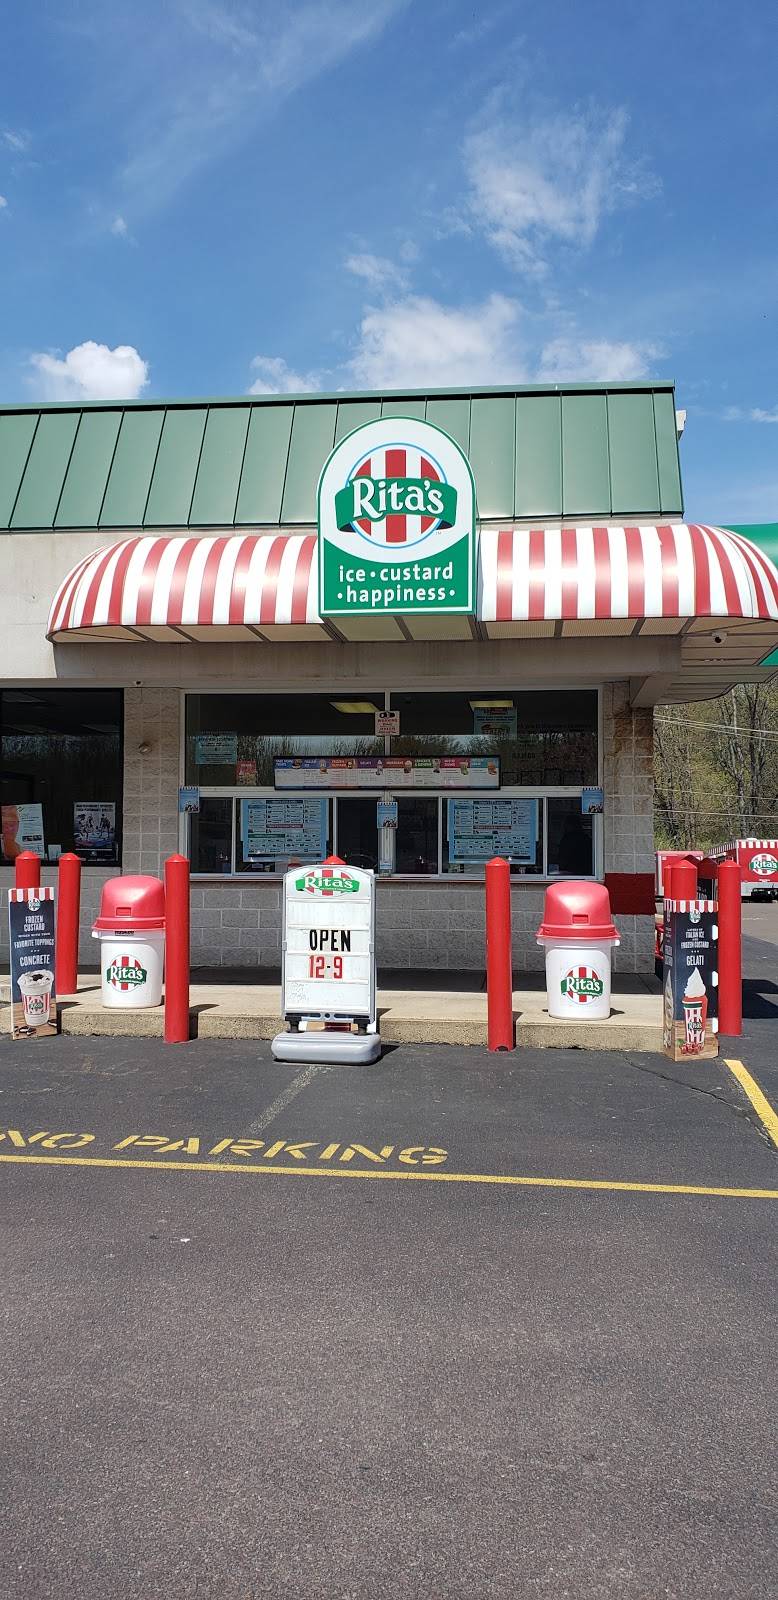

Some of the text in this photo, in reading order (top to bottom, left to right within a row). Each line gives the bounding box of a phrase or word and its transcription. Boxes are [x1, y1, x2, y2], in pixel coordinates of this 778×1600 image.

[353, 478, 444, 519] Rita's
[339, 562, 453, 582] ice custard
[346, 585, 446, 607] happiness
[753, 861, 777, 869] Rita's
[304, 876, 353, 889] Rita's
[23, 922, 45, 932] CUSTARD
[25, 915, 44, 924] FROZEN
[309, 929, 351, 952] OPEN
[20, 954, 50, 967] CONCRETE
[686, 955, 704, 966] GELATI
[110, 965, 143, 981] Rita's
[567, 976, 600, 992] Rita's
[0, 1129, 449, 1166] NO PARKING
